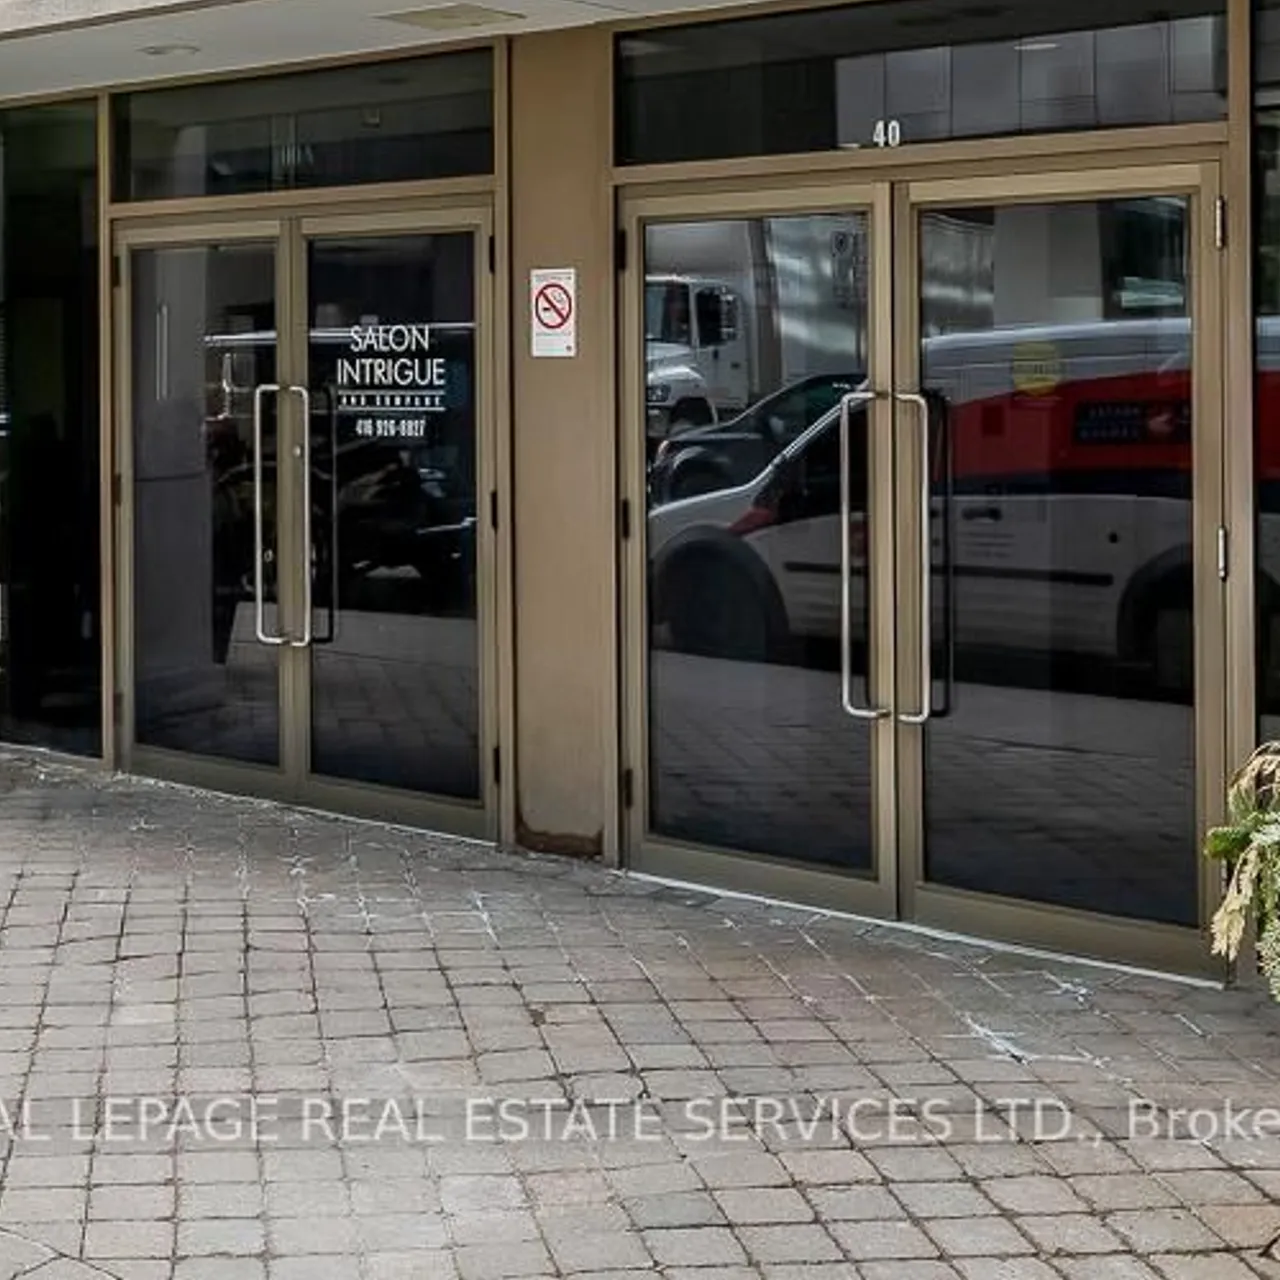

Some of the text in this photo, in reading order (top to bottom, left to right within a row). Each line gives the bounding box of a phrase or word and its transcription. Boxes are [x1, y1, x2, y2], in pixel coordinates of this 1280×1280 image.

[872, 119, 901, 148] 40
[349, 324, 430, 353] SALON
[336, 357, 446, 386] INTRIGUE
